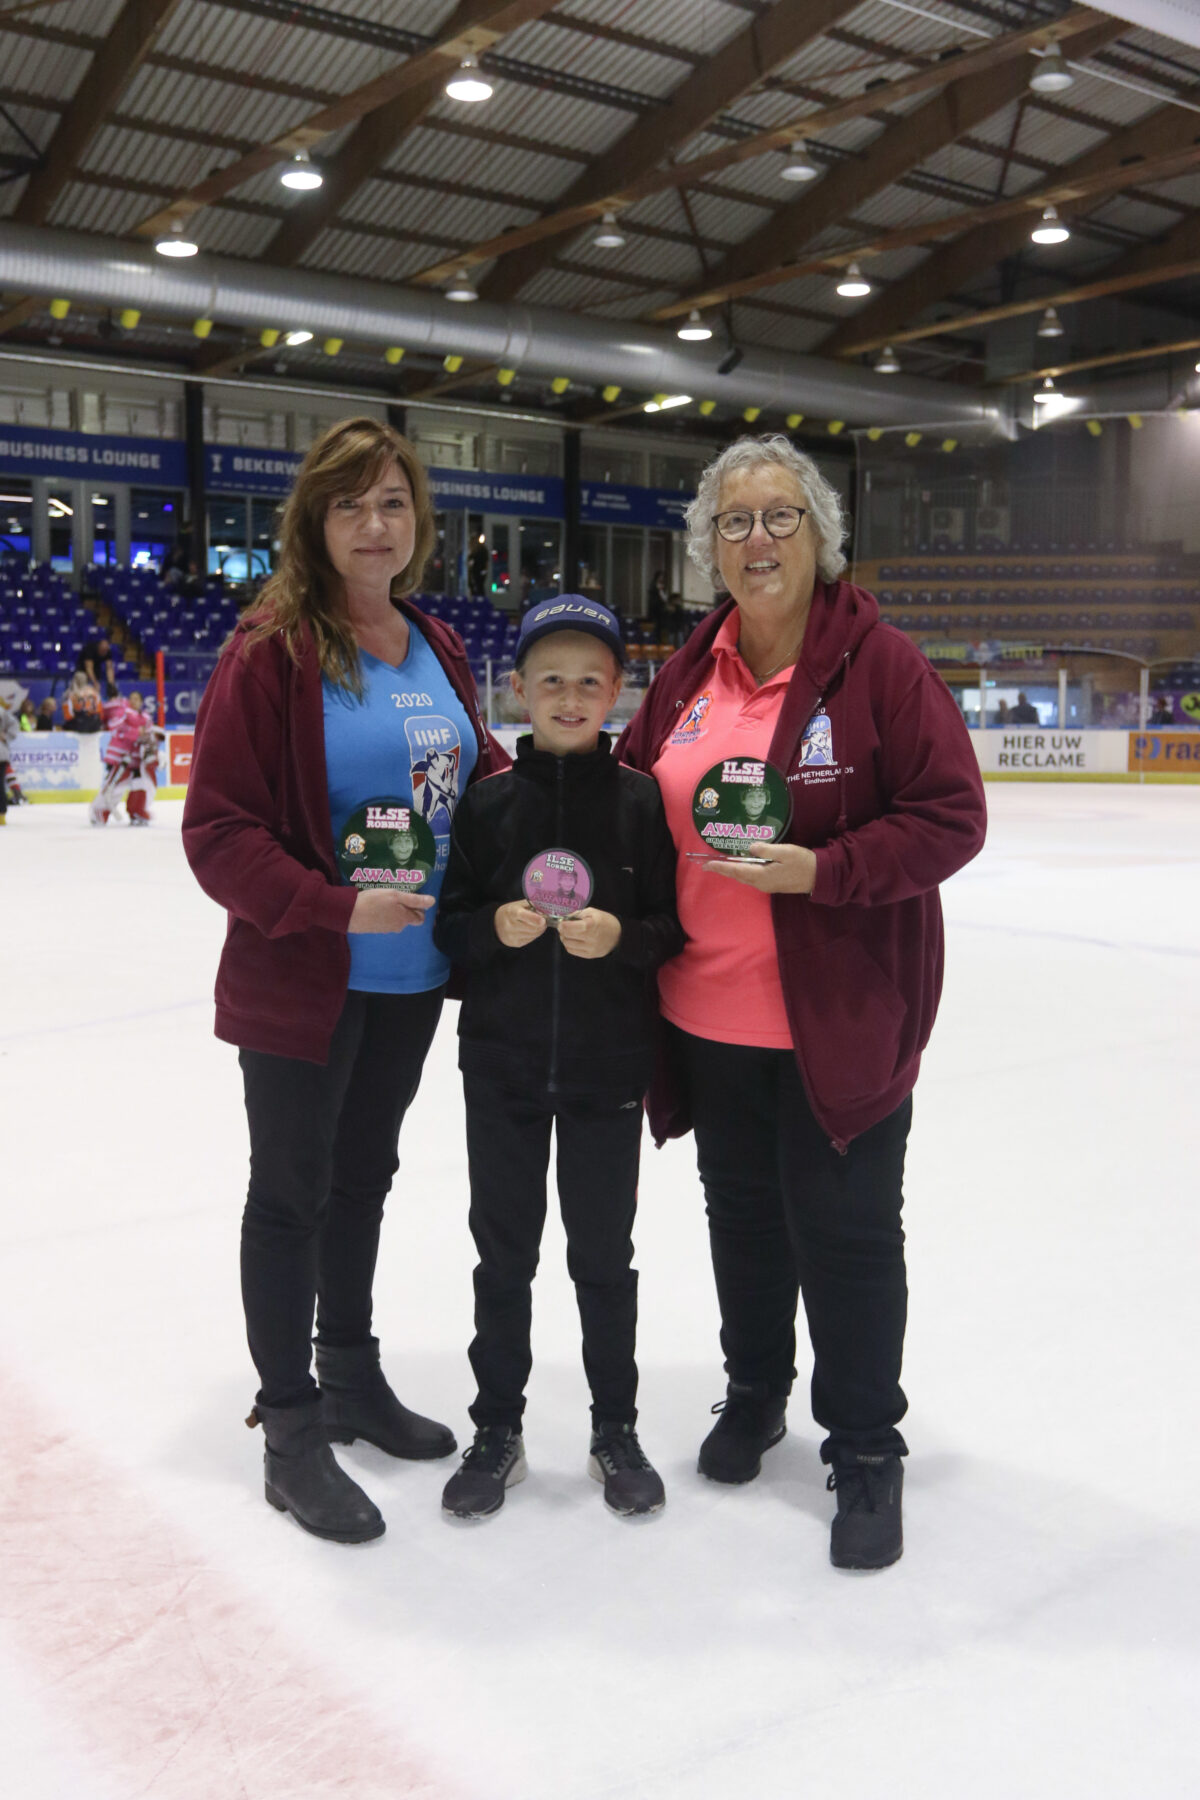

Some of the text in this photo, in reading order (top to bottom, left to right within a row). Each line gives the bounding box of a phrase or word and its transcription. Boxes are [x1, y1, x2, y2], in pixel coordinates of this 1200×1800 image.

[0, 440, 160, 469] BUSINESS LOUNGE
[428, 481, 545, 504] USINESS LOUNGE
[391, 693, 433, 708] 2020
[414, 728, 451, 746] IIHF
[1003, 736, 1082, 749] HIER UW
[9, 751, 79, 762] ATERSTAD
[998, 753, 1086, 767] RECLAME
[722, 761, 765, 776] ILSE
[721, 774, 765, 784] ROBBEN
[786, 773, 800, 783] THE
[804, 777, 836, 785] Eindhoven
[367, 807, 410, 821] ILSE
[366, 820, 410, 830] ROBBEN
[701, 822, 774, 839] AWARD
[546, 854, 575, 866] ILSE
[350, 867, 424, 884] AWARD
